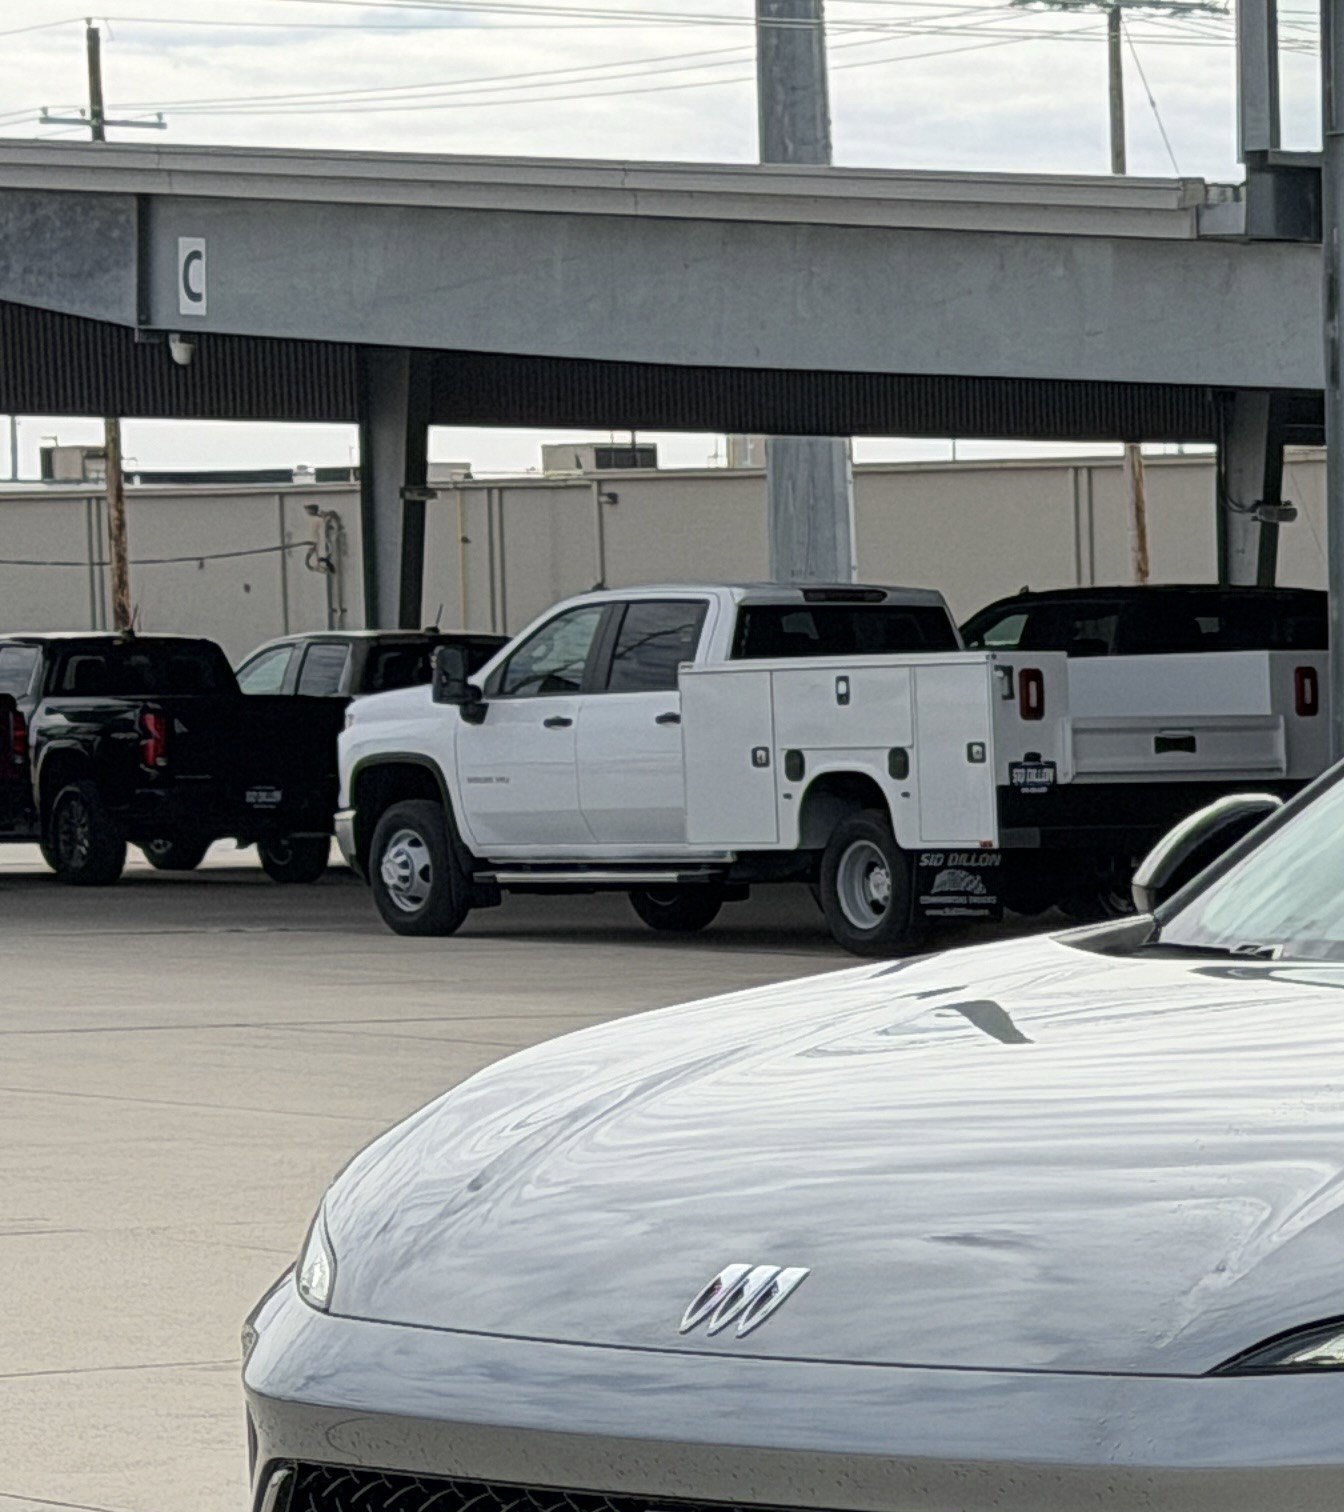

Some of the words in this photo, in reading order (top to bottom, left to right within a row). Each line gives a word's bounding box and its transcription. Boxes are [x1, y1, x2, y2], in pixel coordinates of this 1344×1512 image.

[183, 250, 203, 303] C
[919, 852, 944, 867] SID
[947, 852, 1002, 867] DILLON
